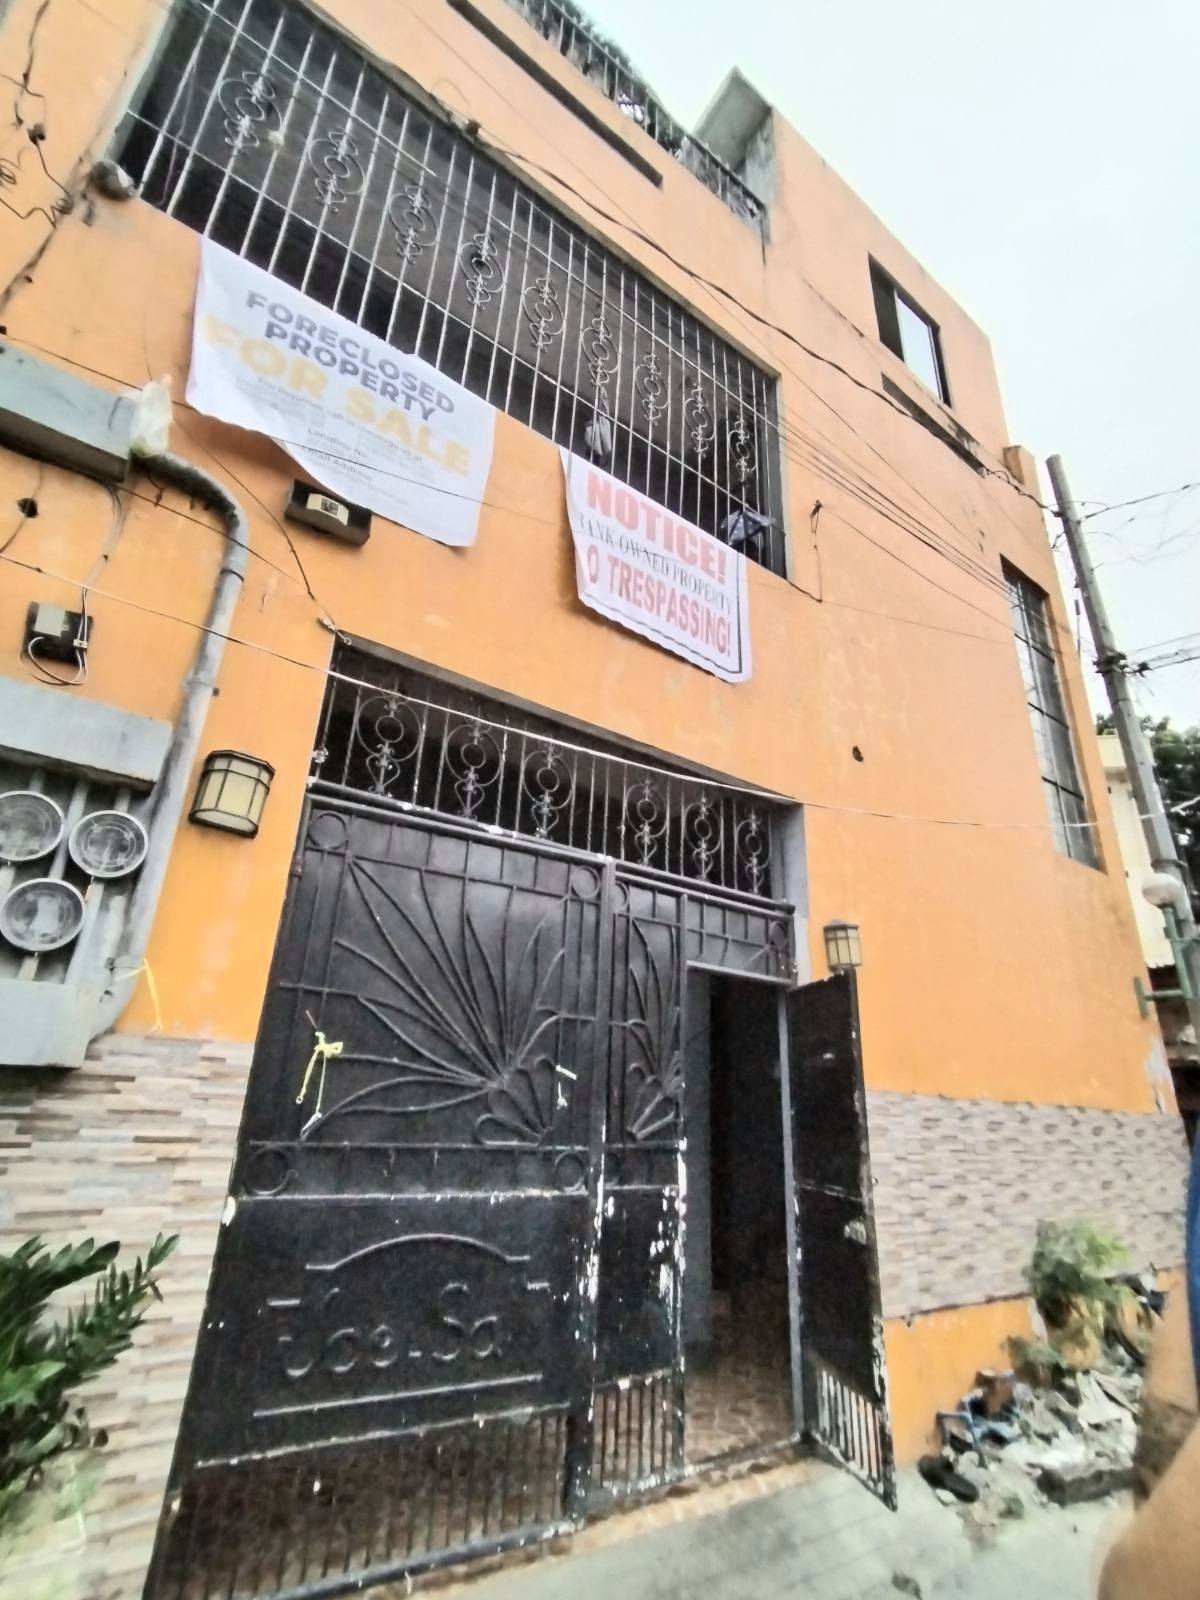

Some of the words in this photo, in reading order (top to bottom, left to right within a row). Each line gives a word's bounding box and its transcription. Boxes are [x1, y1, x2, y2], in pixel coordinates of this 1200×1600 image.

[204, 313, 328, 399] FOR
[345, 385, 471, 477] SALE
[246, 289, 455, 414] FORECLOSED
[264, 321, 436, 422] PROPERTY
[587, 470, 727, 585] NOTICE!
[607, 554, 731, 657] TRESPASSING!
[673, 564, 732, 616] PROPERTY
